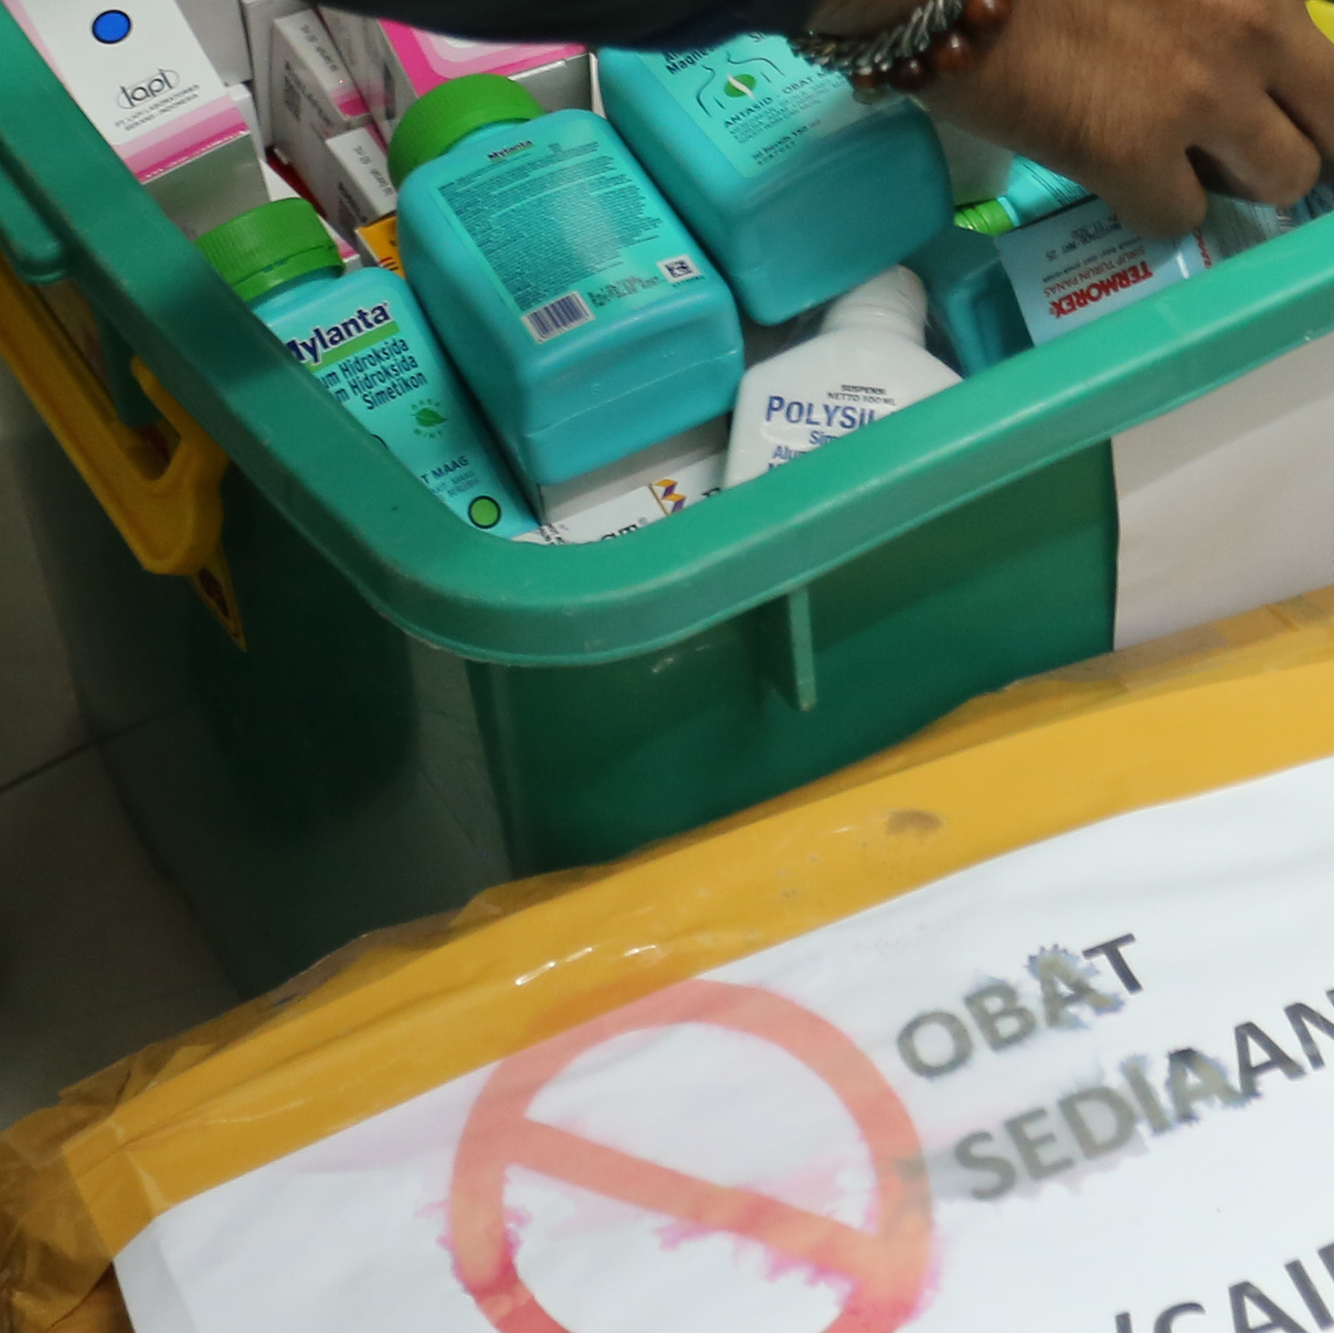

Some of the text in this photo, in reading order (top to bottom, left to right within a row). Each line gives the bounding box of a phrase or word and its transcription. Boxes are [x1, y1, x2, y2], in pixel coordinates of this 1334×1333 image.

[782, 77, 814, 95] OBAT
[488, 140, 534, 161] Mylanta
[1078, 260, 1117, 279] TURUN
[1043, 276, 1079, 298] PANAS
[1051, 261, 1154, 318] TERMOREX
[338, 338, 409, 379] Hidroksida
[348, 354, 418, 397] Hidroksida
[362, 370, 428, 410] Simetikon
[827, 392, 860, 402] NETTO
[430, 455, 469, 480] MAAG
[893, 932, 1147, 1084] OBAT
